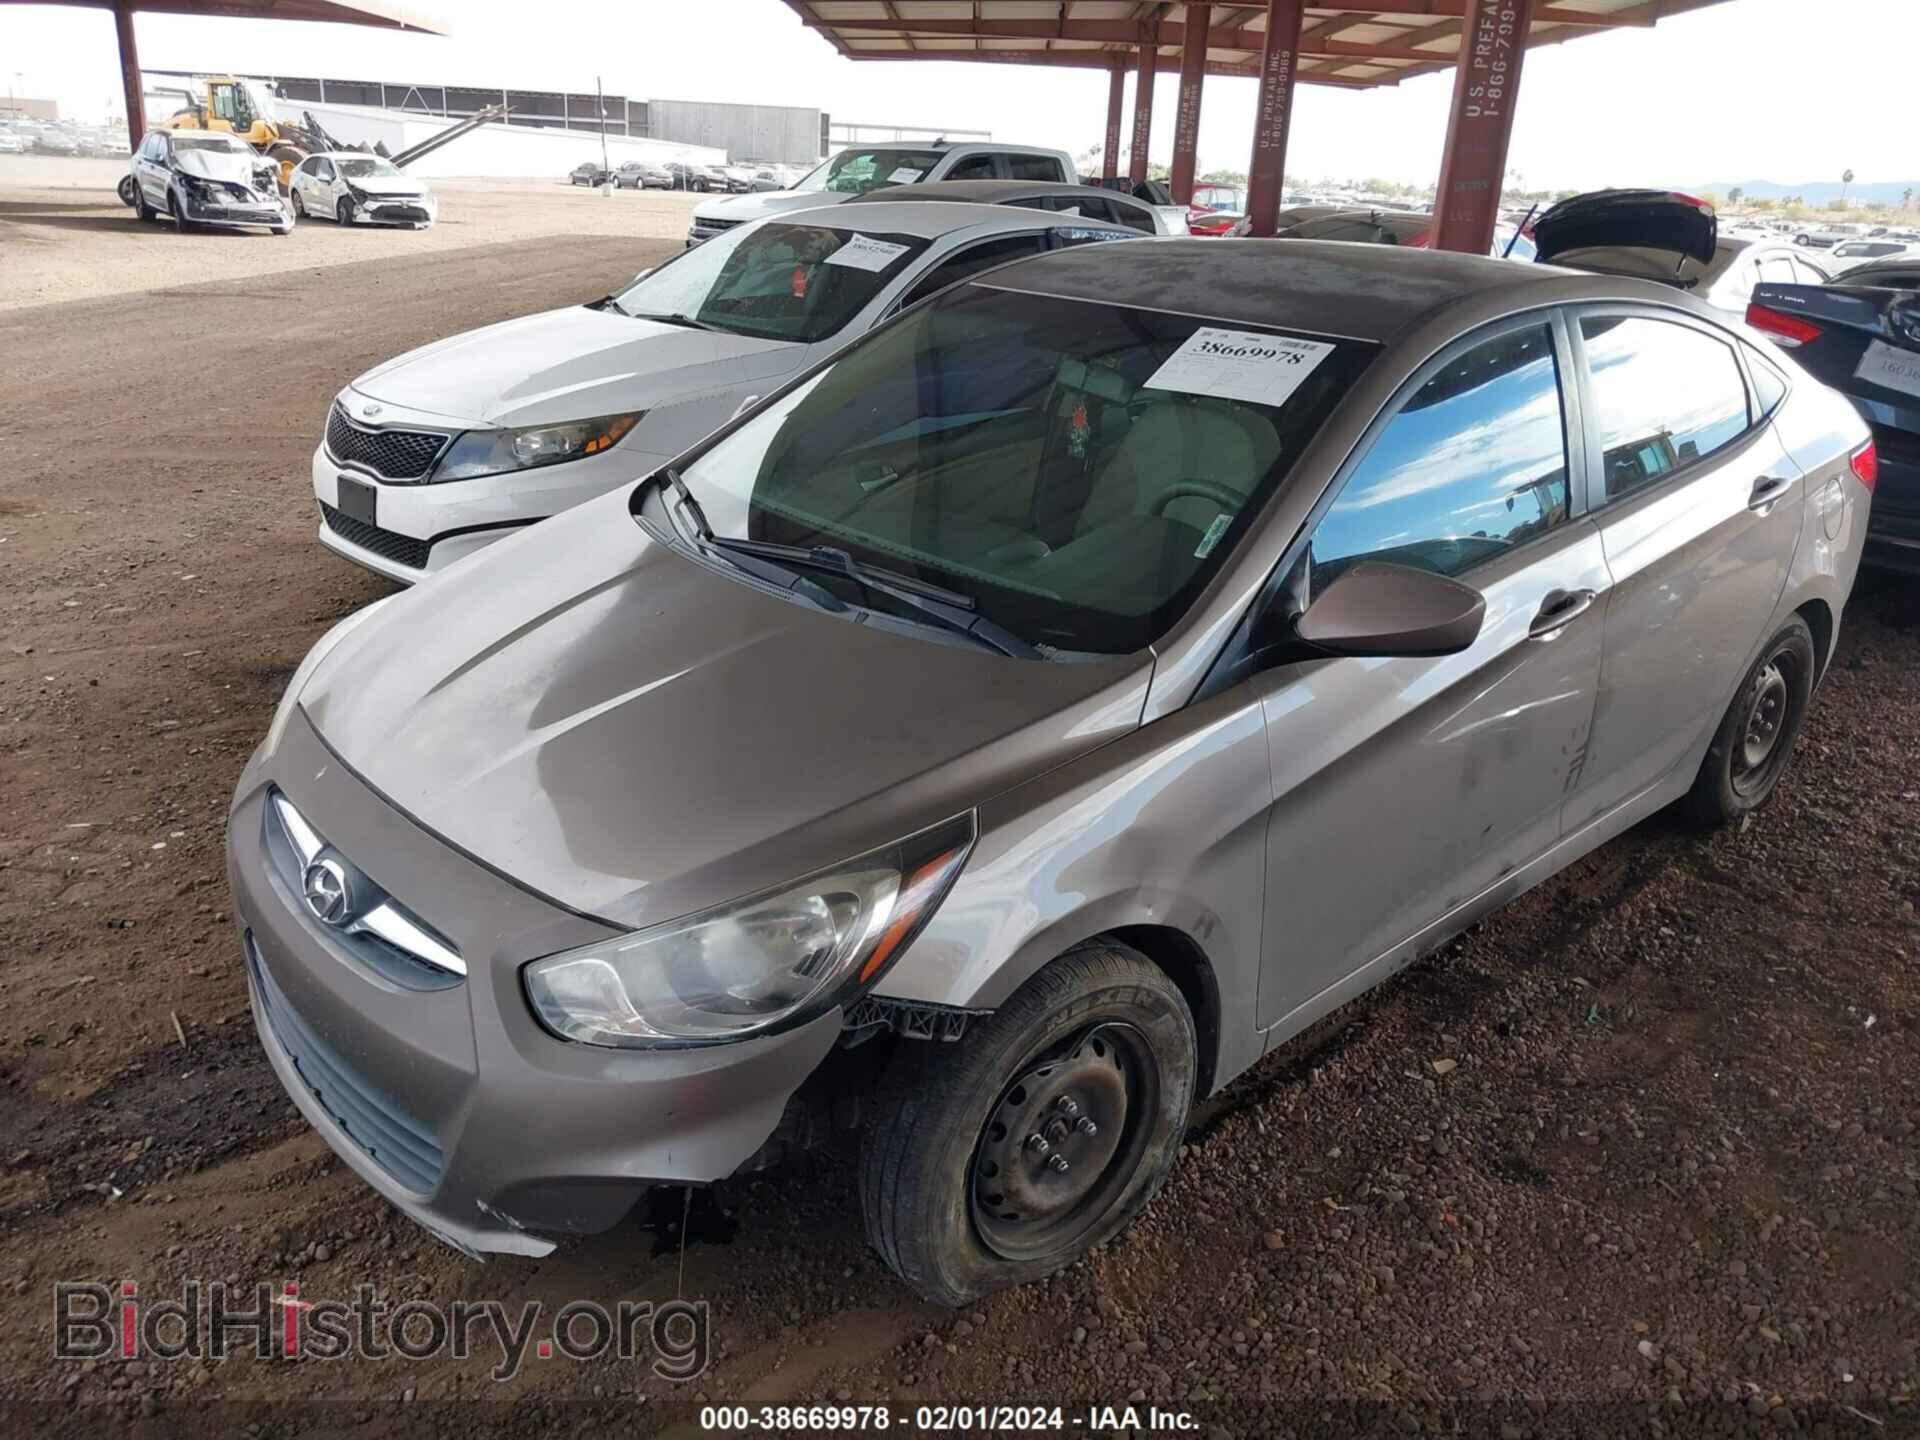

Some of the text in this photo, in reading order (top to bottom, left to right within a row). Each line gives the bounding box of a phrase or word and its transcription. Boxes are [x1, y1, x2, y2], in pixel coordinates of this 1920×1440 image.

[1466, 0, 1499, 117] U.S. PREFA
[1192, 341, 1305, 365] 38669978
